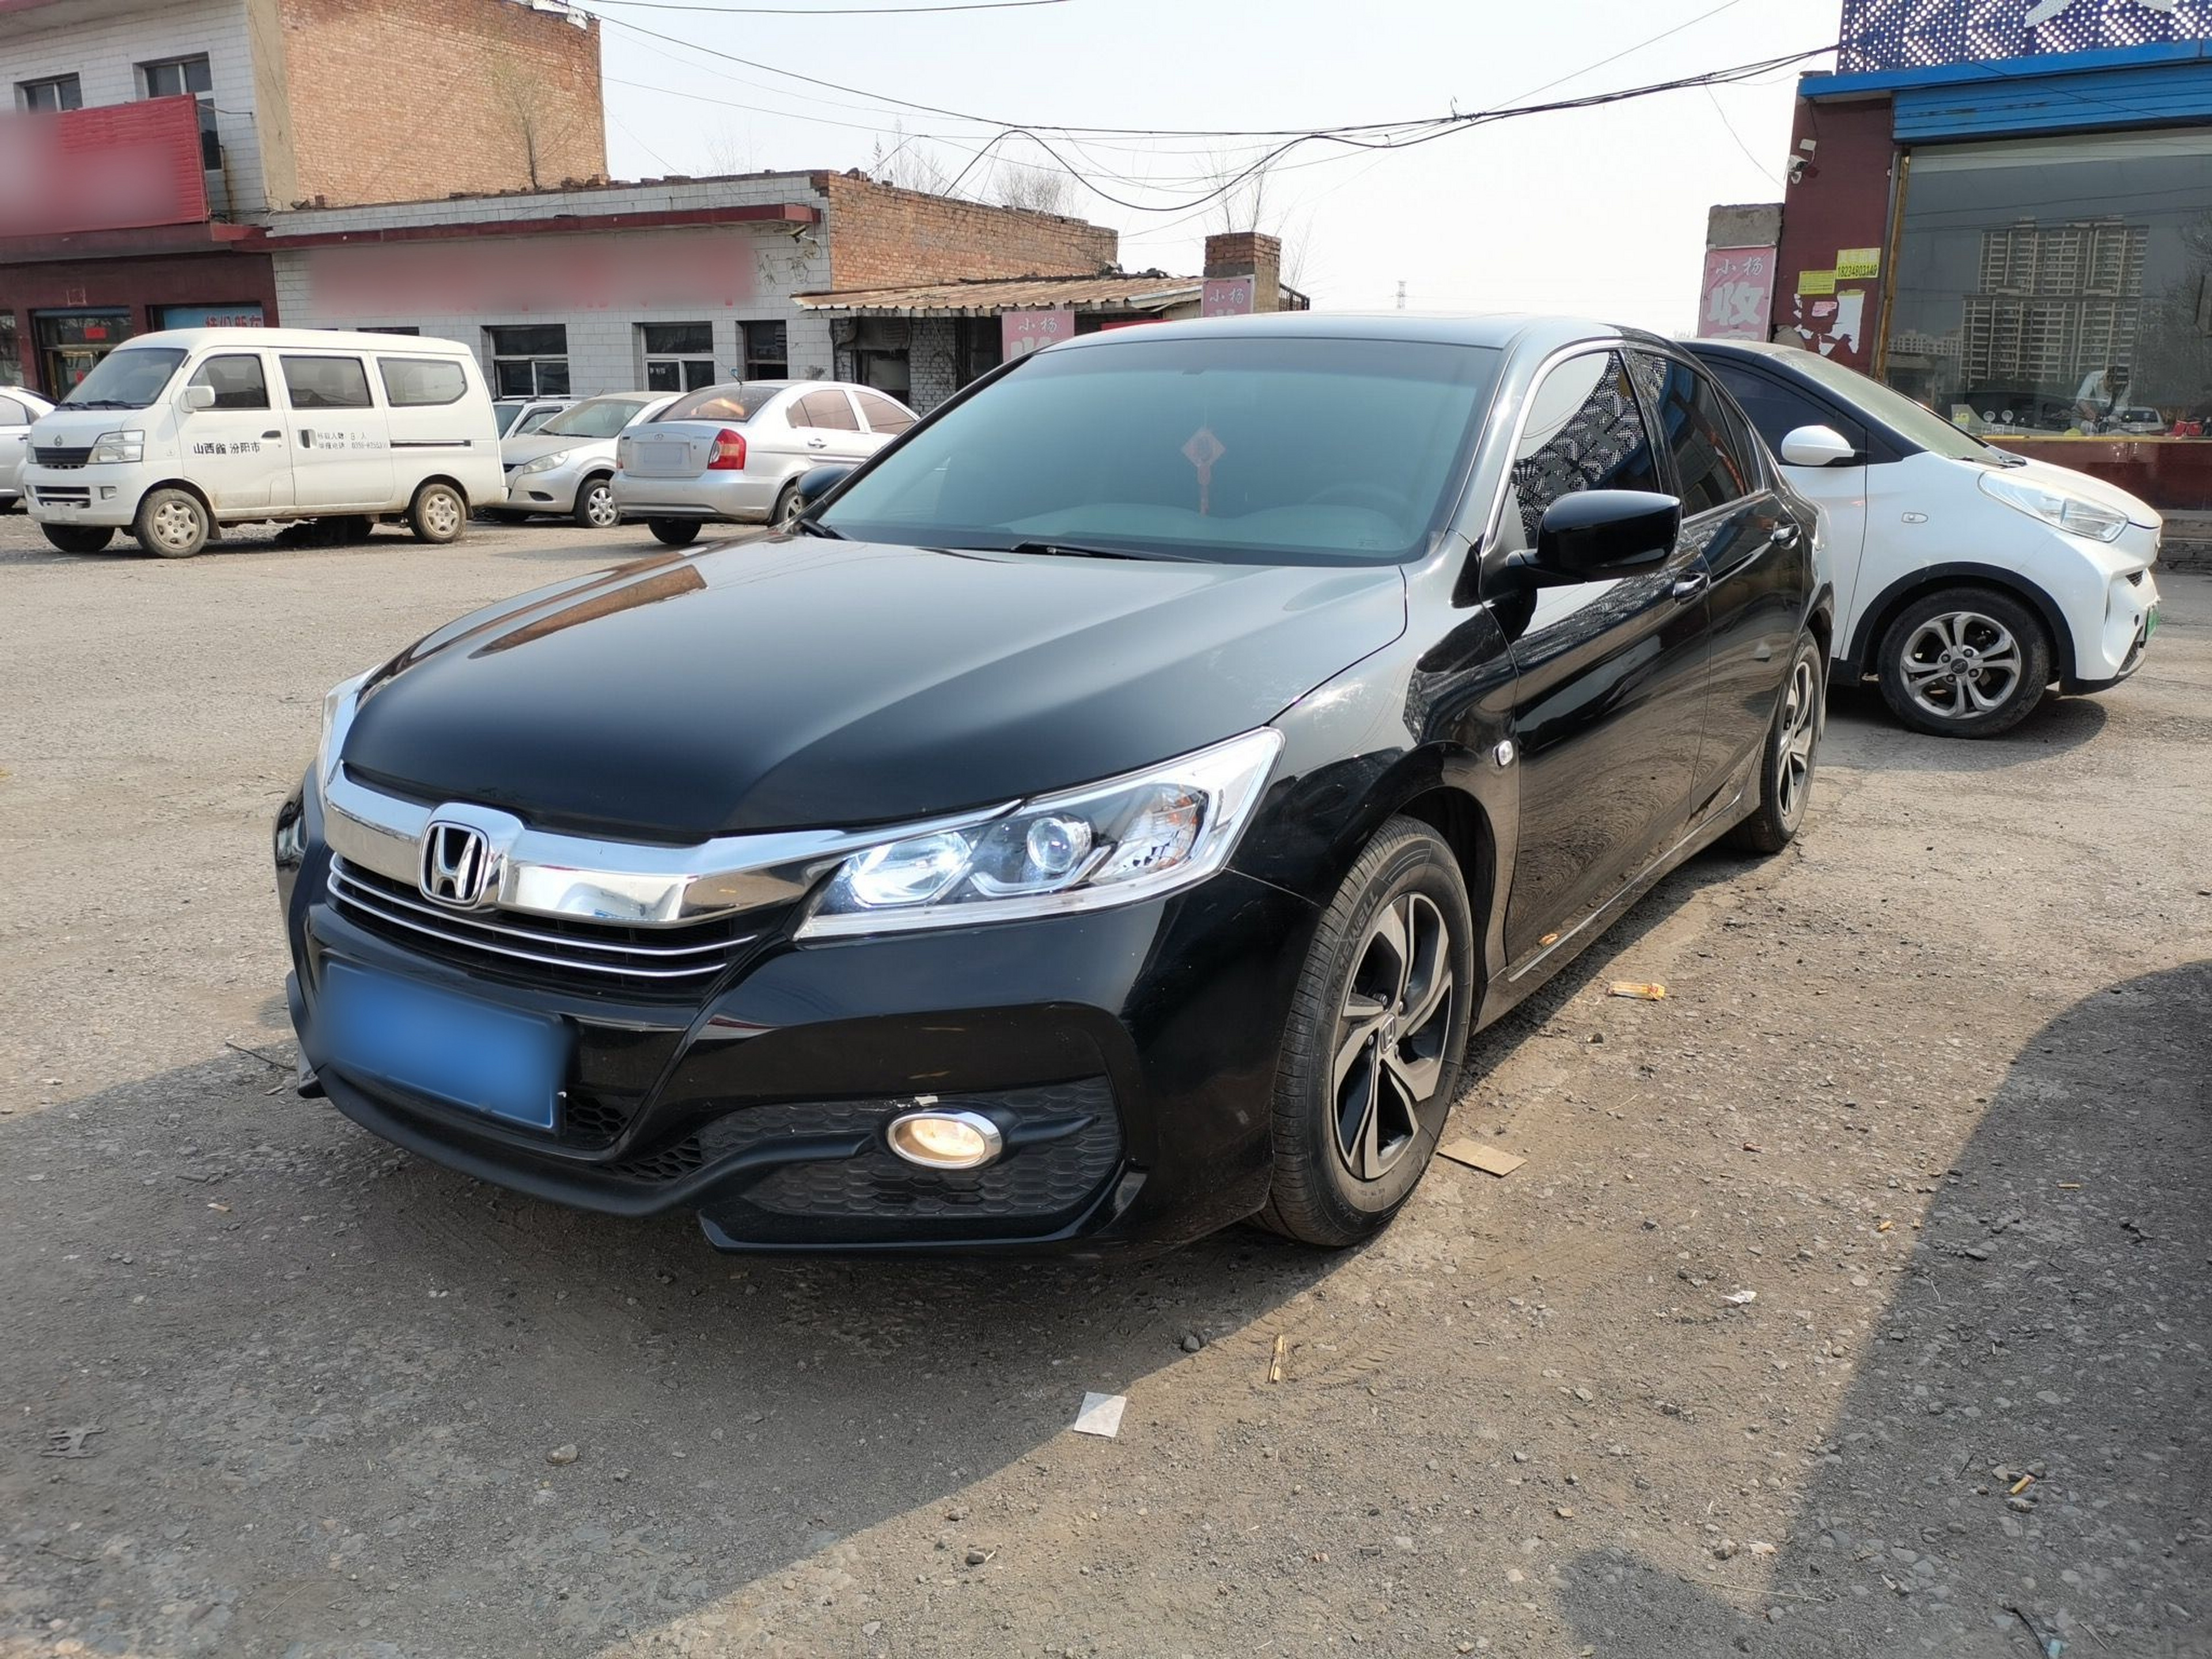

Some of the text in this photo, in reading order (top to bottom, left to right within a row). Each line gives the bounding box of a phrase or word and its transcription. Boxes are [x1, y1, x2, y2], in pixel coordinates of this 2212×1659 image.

[1715, 257, 1764, 276] 小杨
[1210, 287, 1245, 304] 小杨
[1707, 282, 1765, 340] 收
[1018, 317, 1058, 333] 小杨
